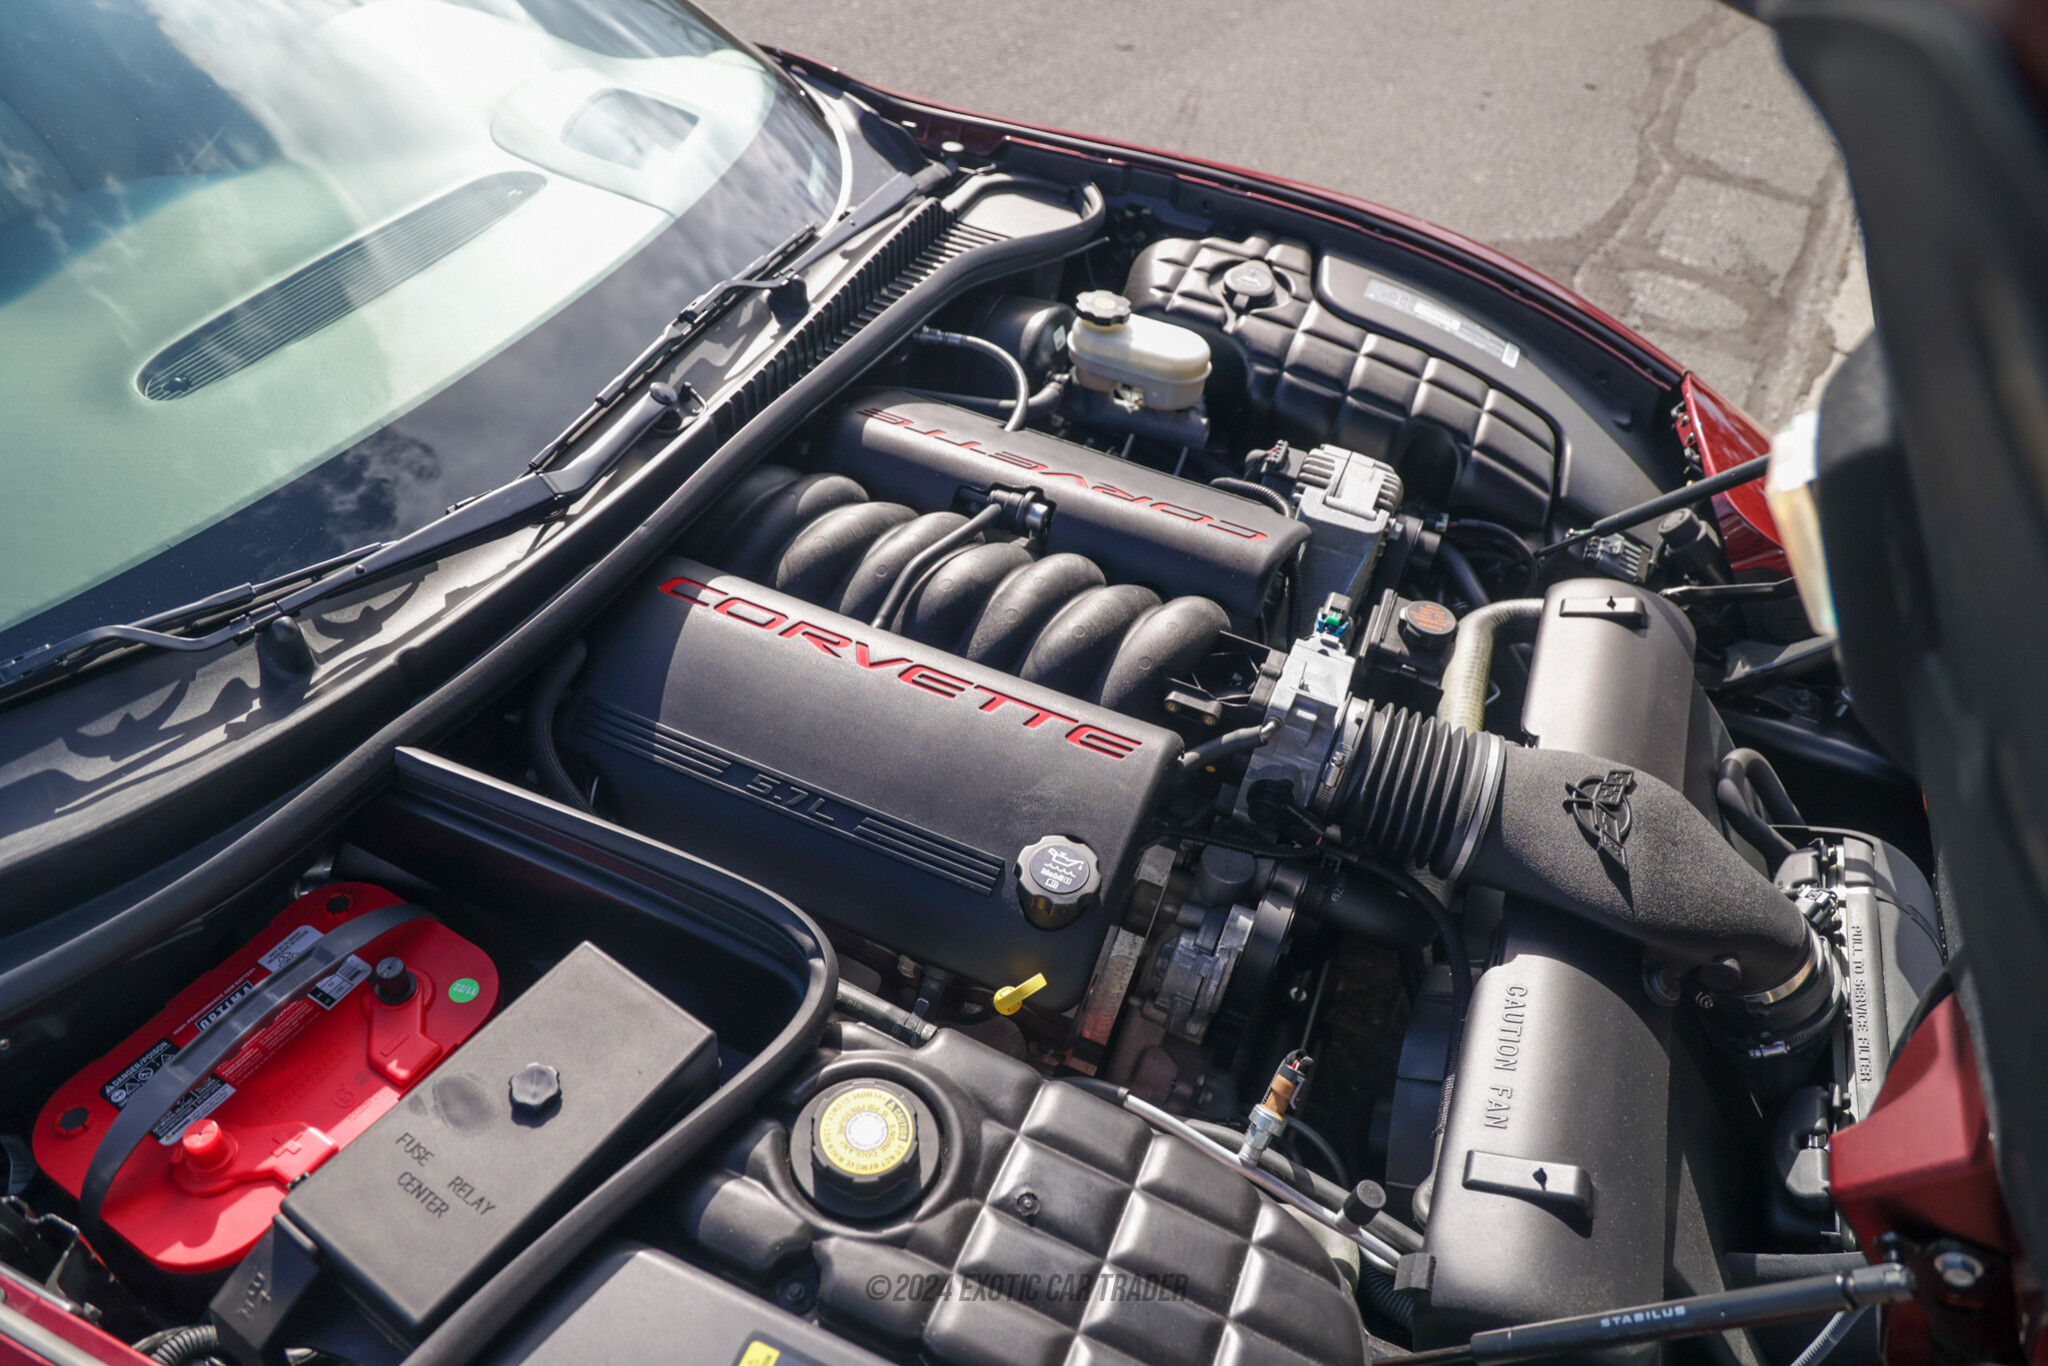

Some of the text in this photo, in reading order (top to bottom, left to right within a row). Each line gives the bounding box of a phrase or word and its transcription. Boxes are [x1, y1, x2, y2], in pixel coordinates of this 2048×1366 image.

[855, 407, 1268, 541] CORVETTE
[658, 575, 1142, 759] CORVETTE
[746, 773, 834, 822] 5.7L
[453, 983, 477, 996] 11/22
[1851, 925, 1873, 1082] PULL TO SERVICE FILTER
[111, 1040, 168, 1088] DANGER/POISON
[1484, 984, 1528, 1130] CAUTION FAN
[395, 1132, 496, 1215] FUSE RELAY
[397, 1171, 450, 1218] CENTER
[1600, 1305, 1686, 1328] STABILUS
